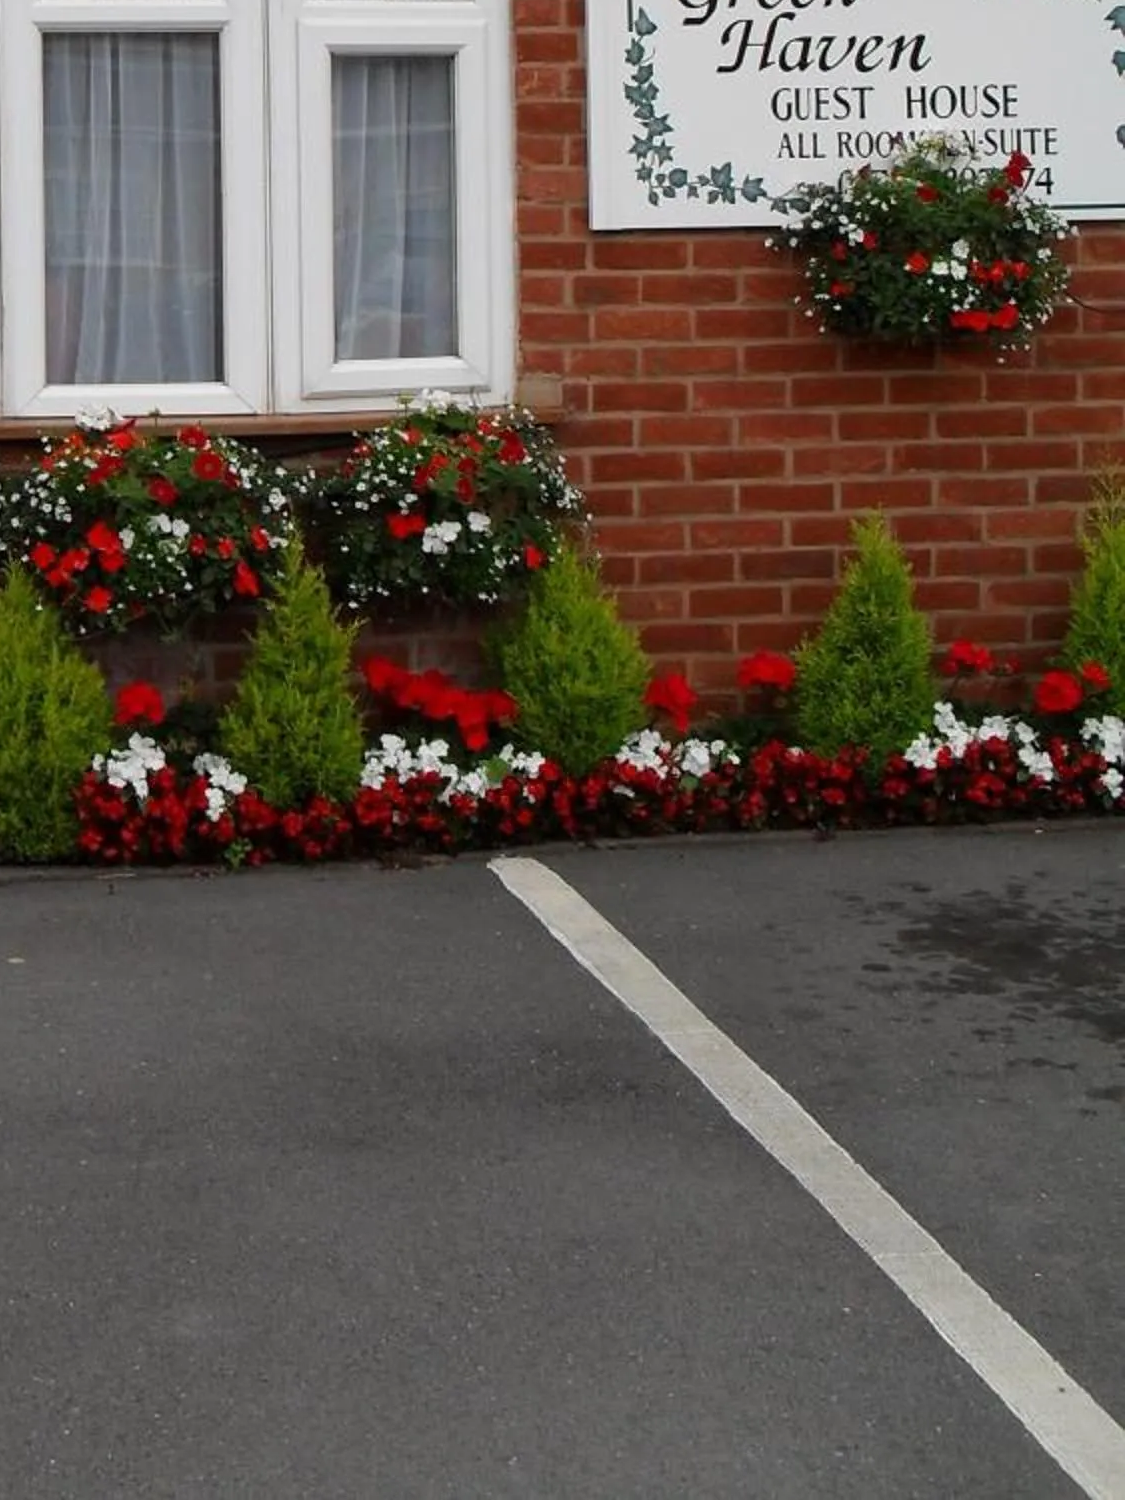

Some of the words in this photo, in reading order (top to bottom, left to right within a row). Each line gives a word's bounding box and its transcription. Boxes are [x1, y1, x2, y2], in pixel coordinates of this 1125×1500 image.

[716, 12, 931, 73] Haven
[771, 86, 875, 121] GUEST
[906, 84, 1018, 119] HOUSE
[777, 132, 826, 159] ALL
[837, 128, 931, 158] ROO
